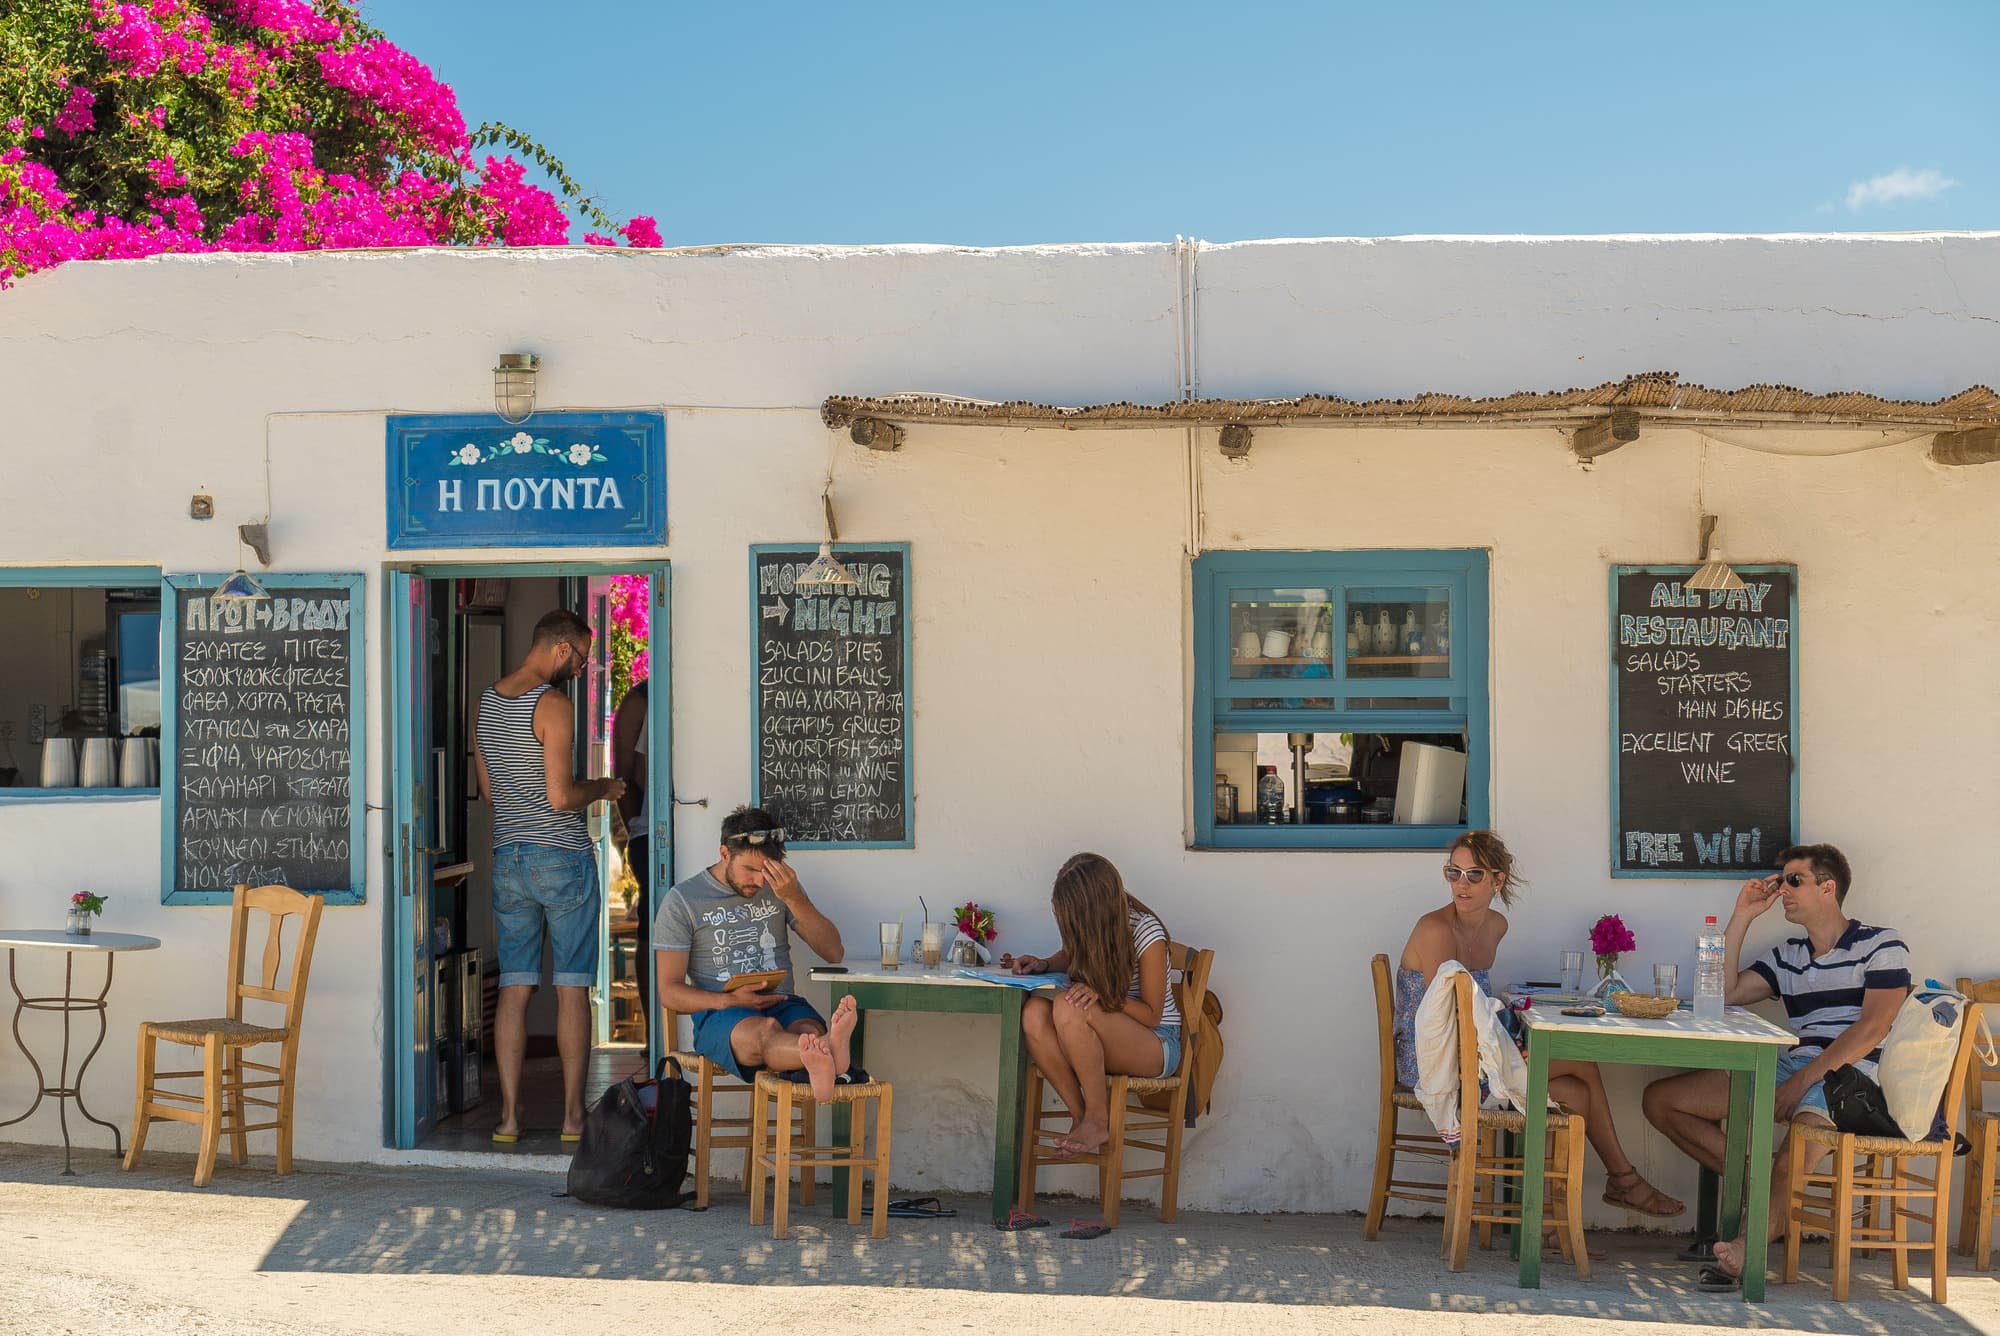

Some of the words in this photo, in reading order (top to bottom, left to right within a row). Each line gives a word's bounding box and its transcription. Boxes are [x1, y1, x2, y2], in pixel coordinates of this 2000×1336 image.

[438, 479, 463, 512] Η
[476, 477, 625, 510] ΠΟΥΝΤΑ
[1650, 582, 1701, 608] ALL
[1709, 582, 1772, 612] DAY
[272, 598, 350, 632] ΒΡΑΔΥ
[792, 596, 897, 636] NIGHT
[1620, 614, 1788, 650] RESTAURANT
[845, 641, 884, 663] PIES
[1626, 650, 1701, 672] SALADS
[760, 666, 831, 686] ZUCCINI
[836, 666, 892, 686] BALLS
[1657, 671, 1752, 695] STARTERS
[762, 689, 811, 712] FAVA,
[865, 690, 904, 714] PASTA
[1678, 700, 1717, 719] MAIN
[1723, 698, 1783, 721] DISHES
[184, 718, 260, 740] ΧΤΑΠΟΔΙ
[293, 718, 349, 743] ΣΧΑΡΑ
[764, 716, 835, 736] OCTAPUS
[842, 715, 901, 738] GRILLED
[1621, 731, 1715, 754] EXCELLENT
[1727, 731, 1788, 755] GREEK
[762, 759, 831, 782] KALAMARI
[856, 760, 899, 782] WINE
[1681, 760, 1736, 783] WINE
[182, 775, 276, 801] ΚΑΛΑΜΑΡΙ
[763, 784, 808, 800] LAMB
[830, 780, 883, 801] LEMON
[182, 806, 248, 832] ΑΡΝΑΚΙ
[261, 803, 350, 829] ΛΕΜΟΝΑΤΟ
[832, 802, 901, 820] STIFADO
[182, 836, 268, 862] ΚΟΥΝΕΛΙ
[1626, 830, 1683, 866] FREE
